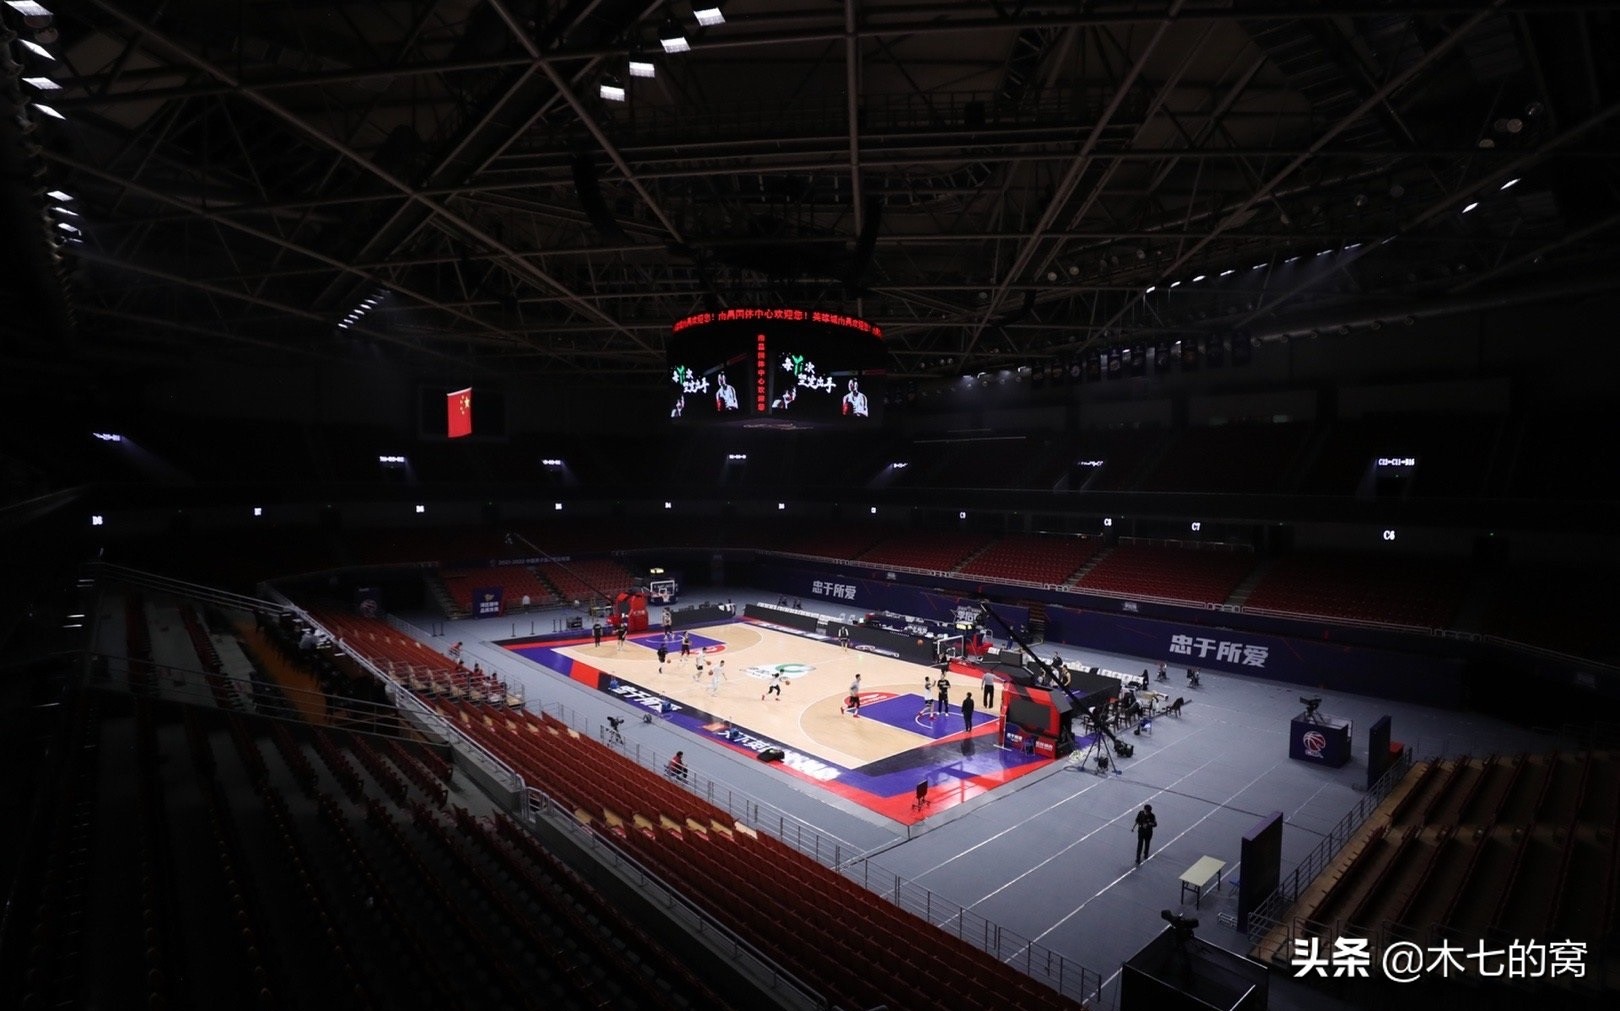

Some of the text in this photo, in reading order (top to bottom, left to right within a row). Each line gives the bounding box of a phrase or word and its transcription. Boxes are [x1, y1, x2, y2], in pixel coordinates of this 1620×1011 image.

[1191, 522, 1201, 531] C7
[1383, 530, 1395, 541] C6
[812, 580, 857, 600] 忠于所爱
[1169, 634, 1269, 668] 忠于所爱
